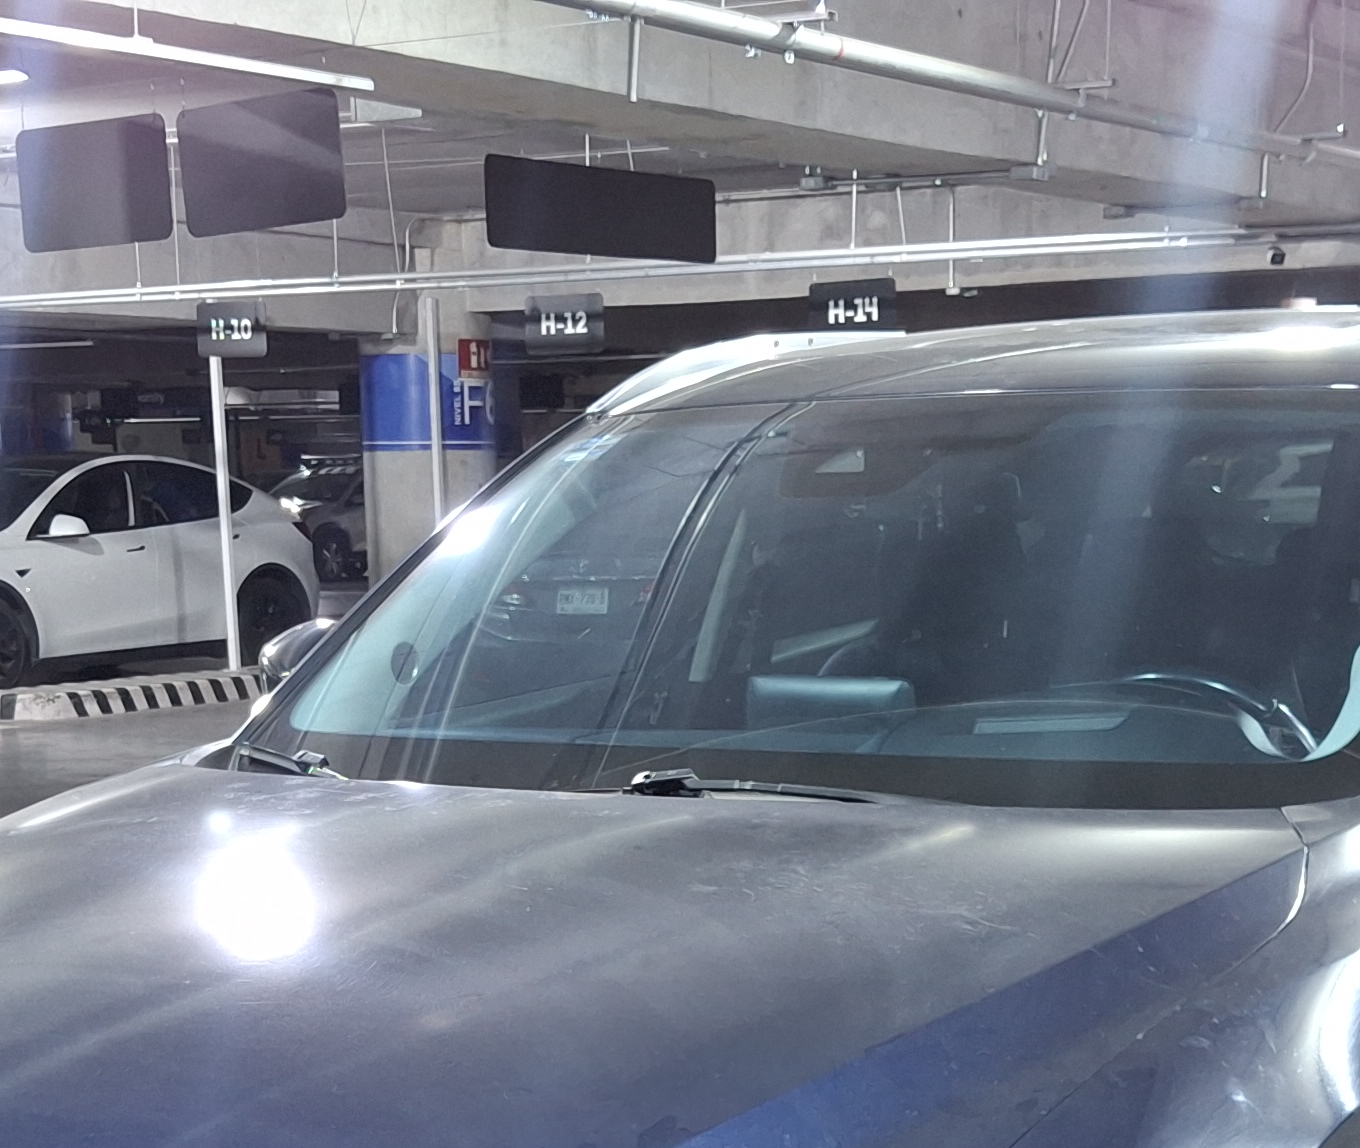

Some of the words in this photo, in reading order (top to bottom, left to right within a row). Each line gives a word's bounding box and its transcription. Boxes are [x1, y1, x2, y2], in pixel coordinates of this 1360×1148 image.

[827, 295, 879, 325] H-14
[210, 318, 253, 341] H-10
[540, 311, 589, 336] H-12
